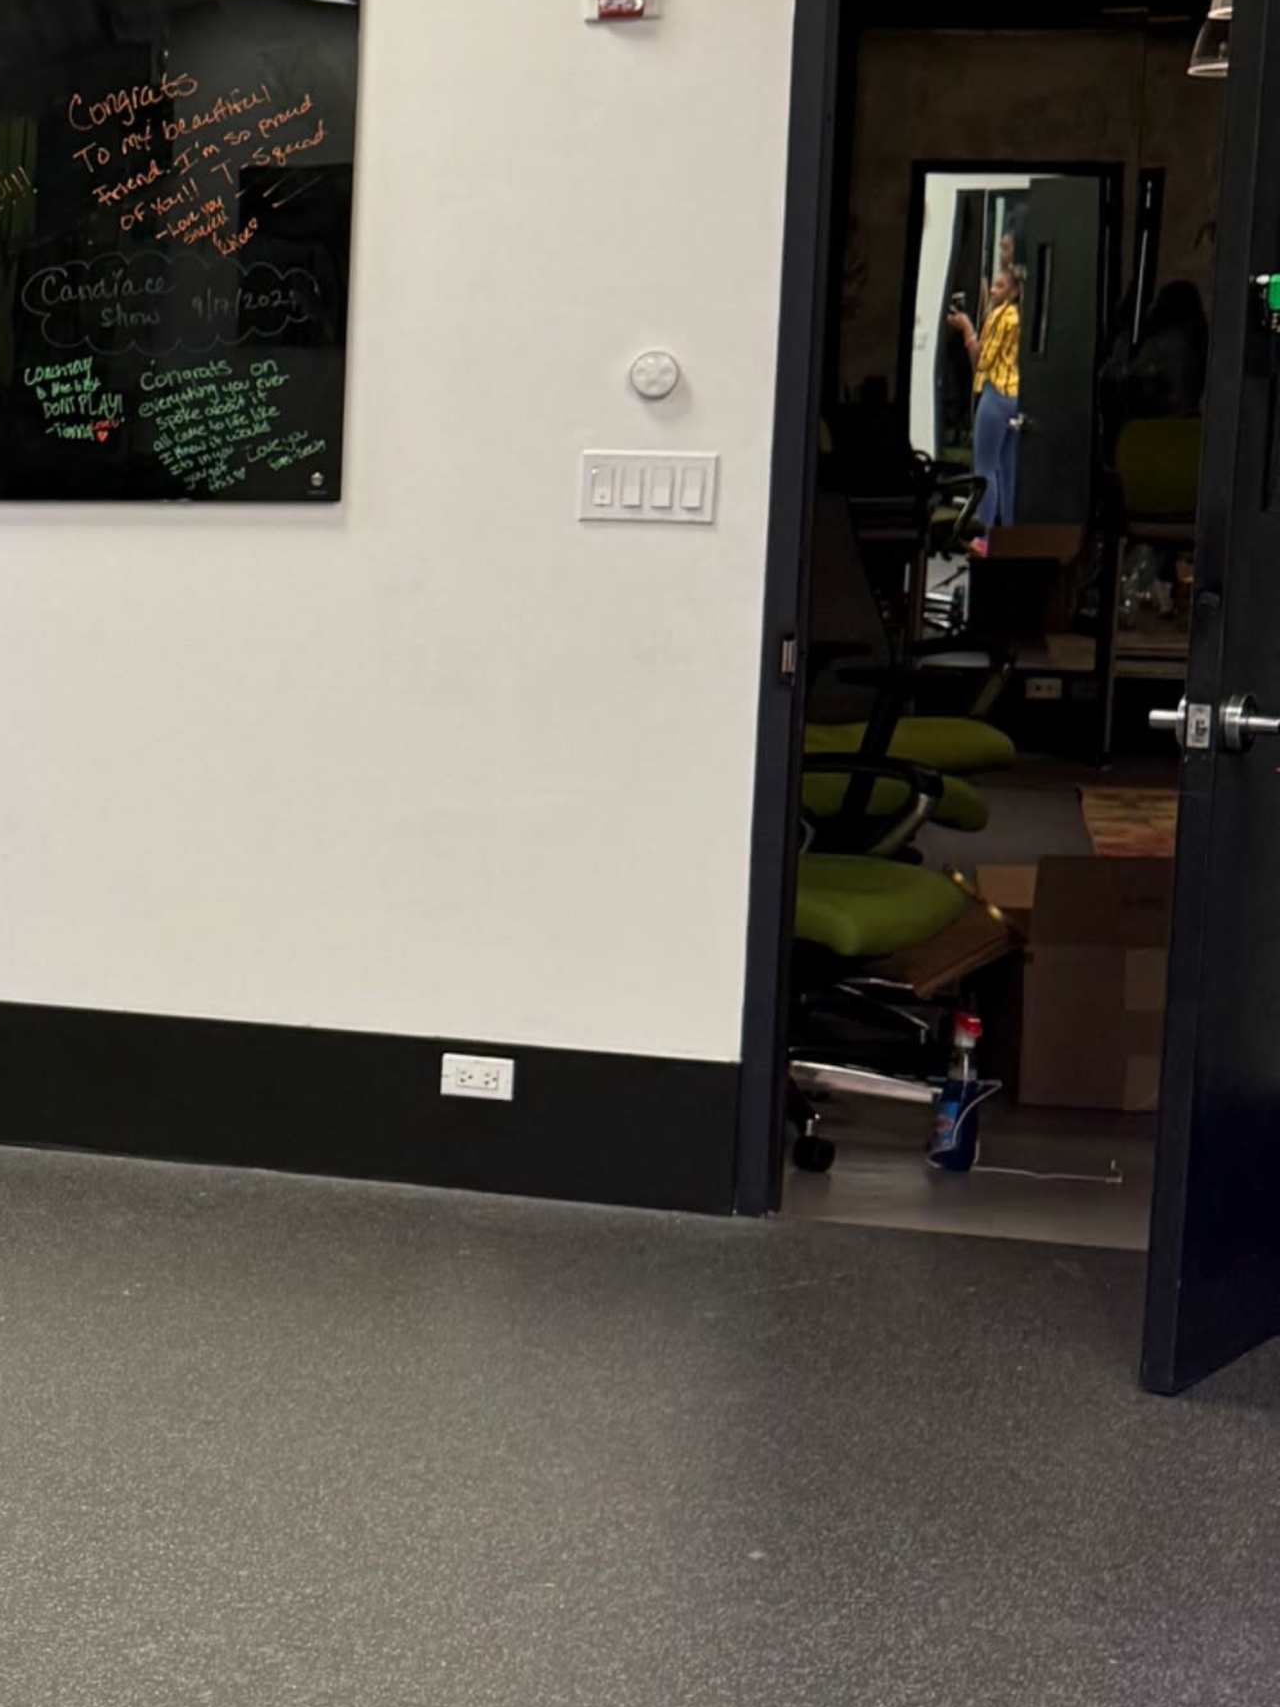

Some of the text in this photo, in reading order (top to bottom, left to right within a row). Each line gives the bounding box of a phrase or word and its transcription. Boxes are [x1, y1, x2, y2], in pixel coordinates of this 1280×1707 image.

[68, 72, 199, 132] Congrats
[173, 140, 220, 176] I'm
[223, 130, 252, 146] so
[257, 93, 314, 138] proud
[72, 142, 111, 174] To
[249, 359, 279, 376] on
[222, 380, 250, 404] you
